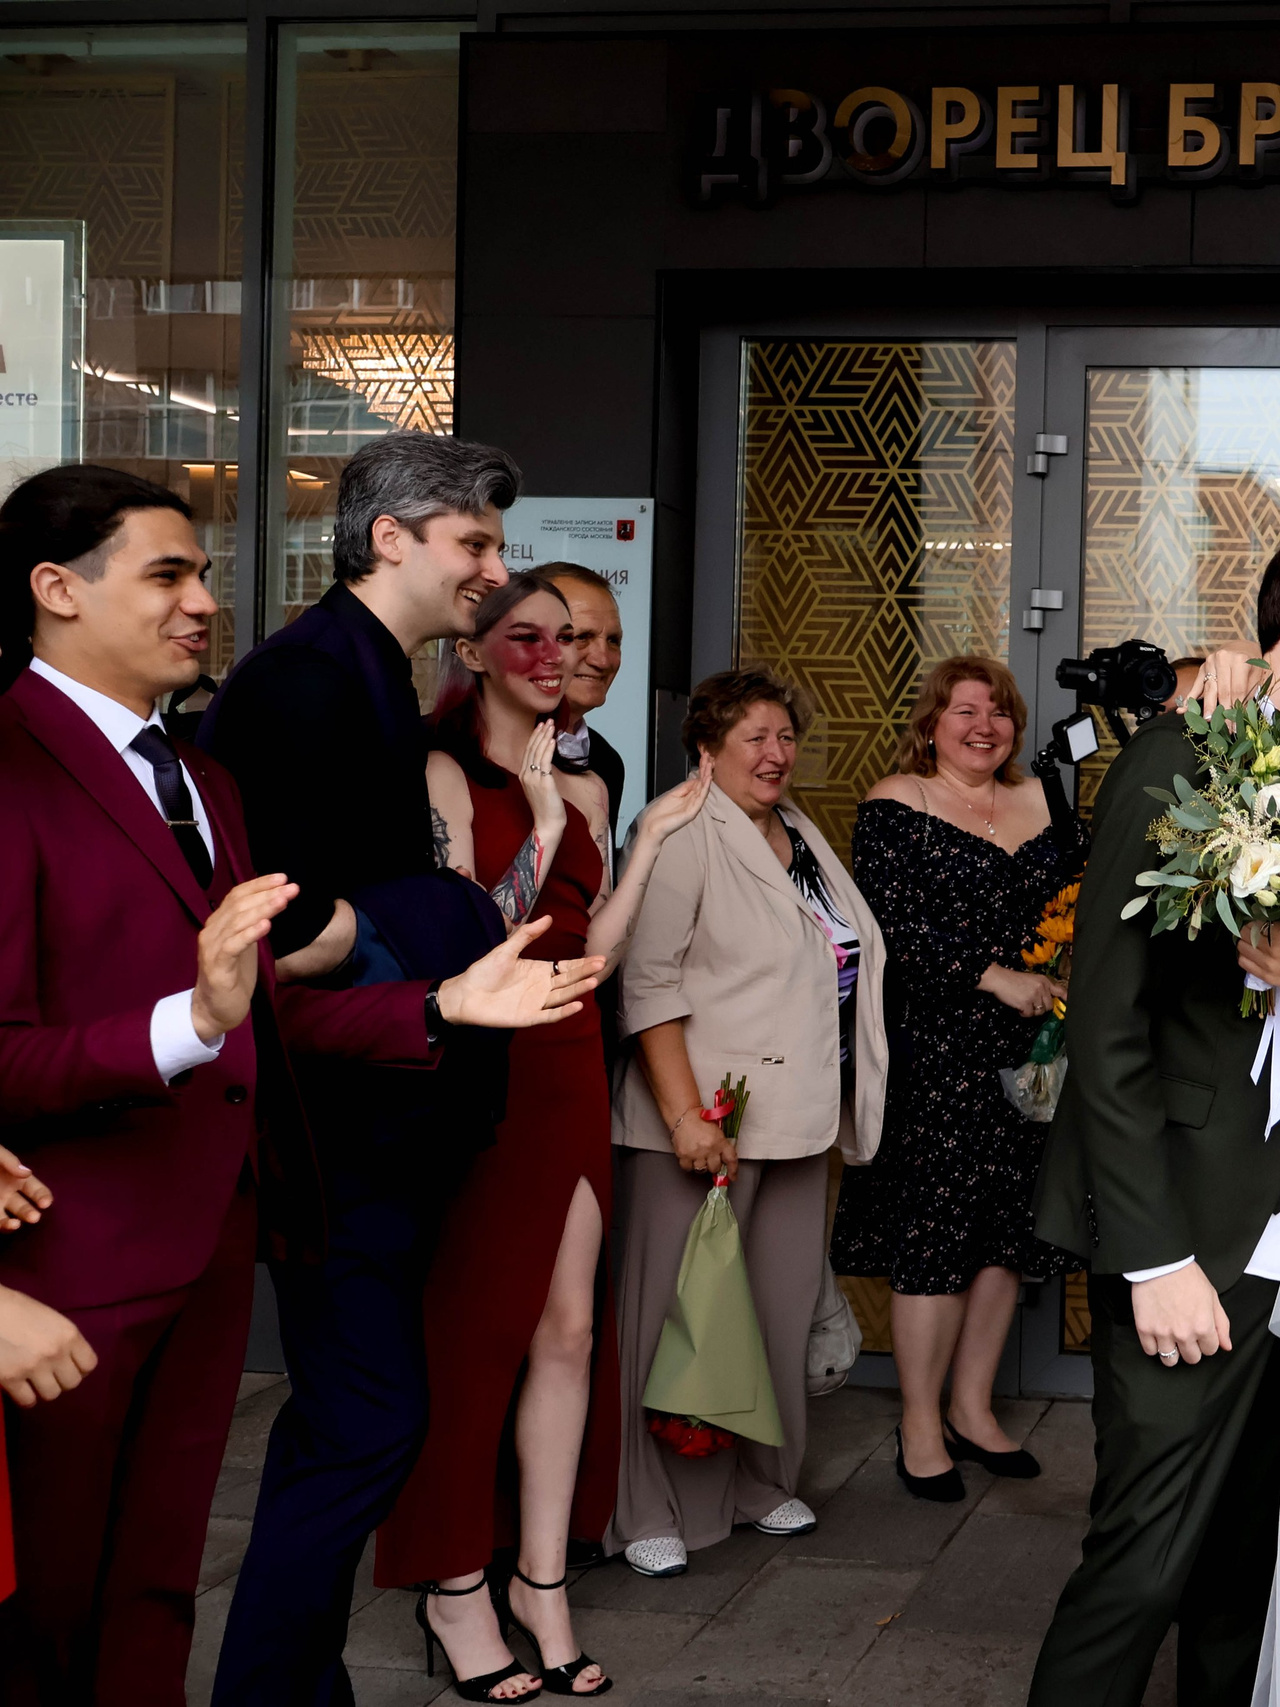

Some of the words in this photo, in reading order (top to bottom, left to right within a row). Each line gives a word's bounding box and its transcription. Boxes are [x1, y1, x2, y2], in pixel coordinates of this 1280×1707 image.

[688, 84, 1135, 200] ДВОРЕЦ
[0, 392, 39, 407] сте
[499, 543, 534, 562] РЕЦ
